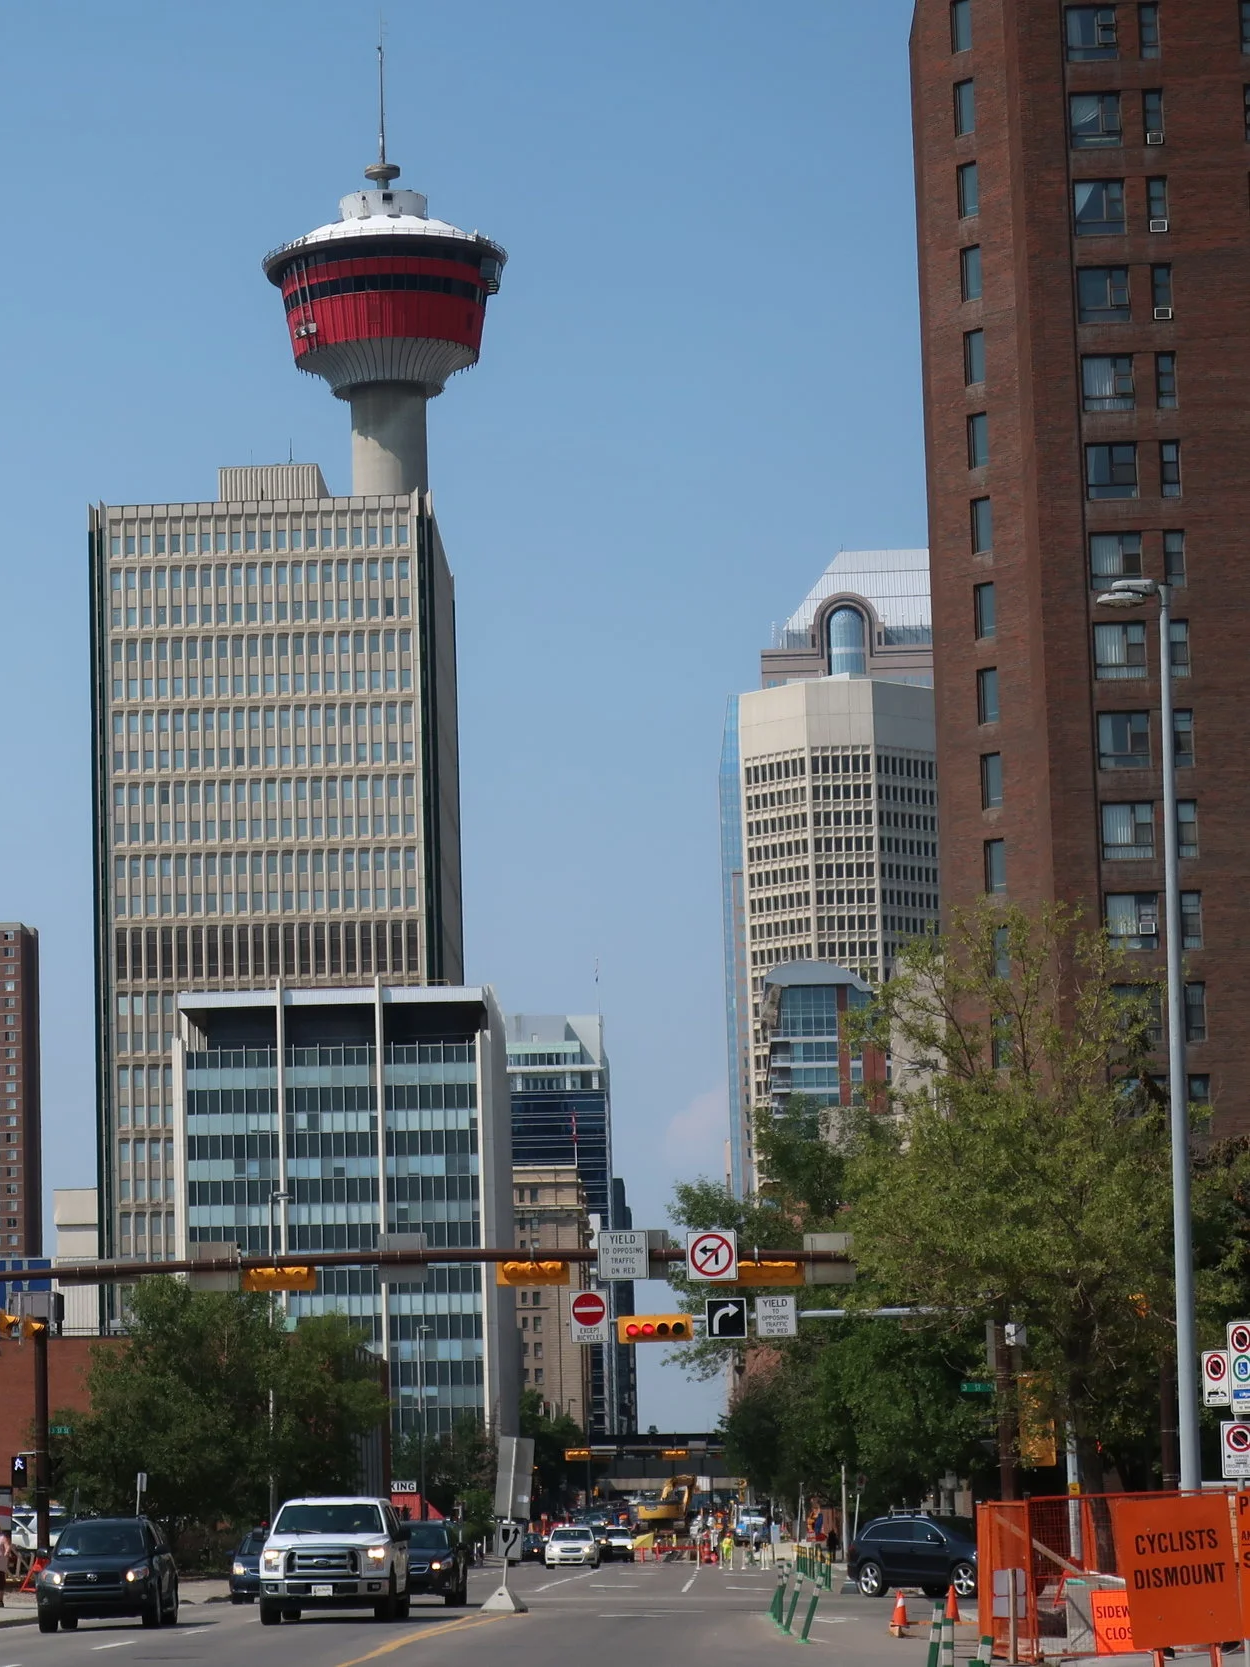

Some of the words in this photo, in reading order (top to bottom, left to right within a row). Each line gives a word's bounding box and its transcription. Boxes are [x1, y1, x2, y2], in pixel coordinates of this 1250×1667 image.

[610, 1234, 636, 1244] YIELD
[602, 1247, 610, 1255] TO
[612, 1247, 644, 1255] OPPOSING
[611, 1267, 620, 1275] ON
[623, 1267, 636, 1275] RED
[762, 1299, 788, 1308] YIELD
[576, 1334, 604, 1342] BICYCLES
[1135, 1528, 1219, 1555] CYCLISTS
[1134, 1562, 1225, 1590] DISMOUNT
